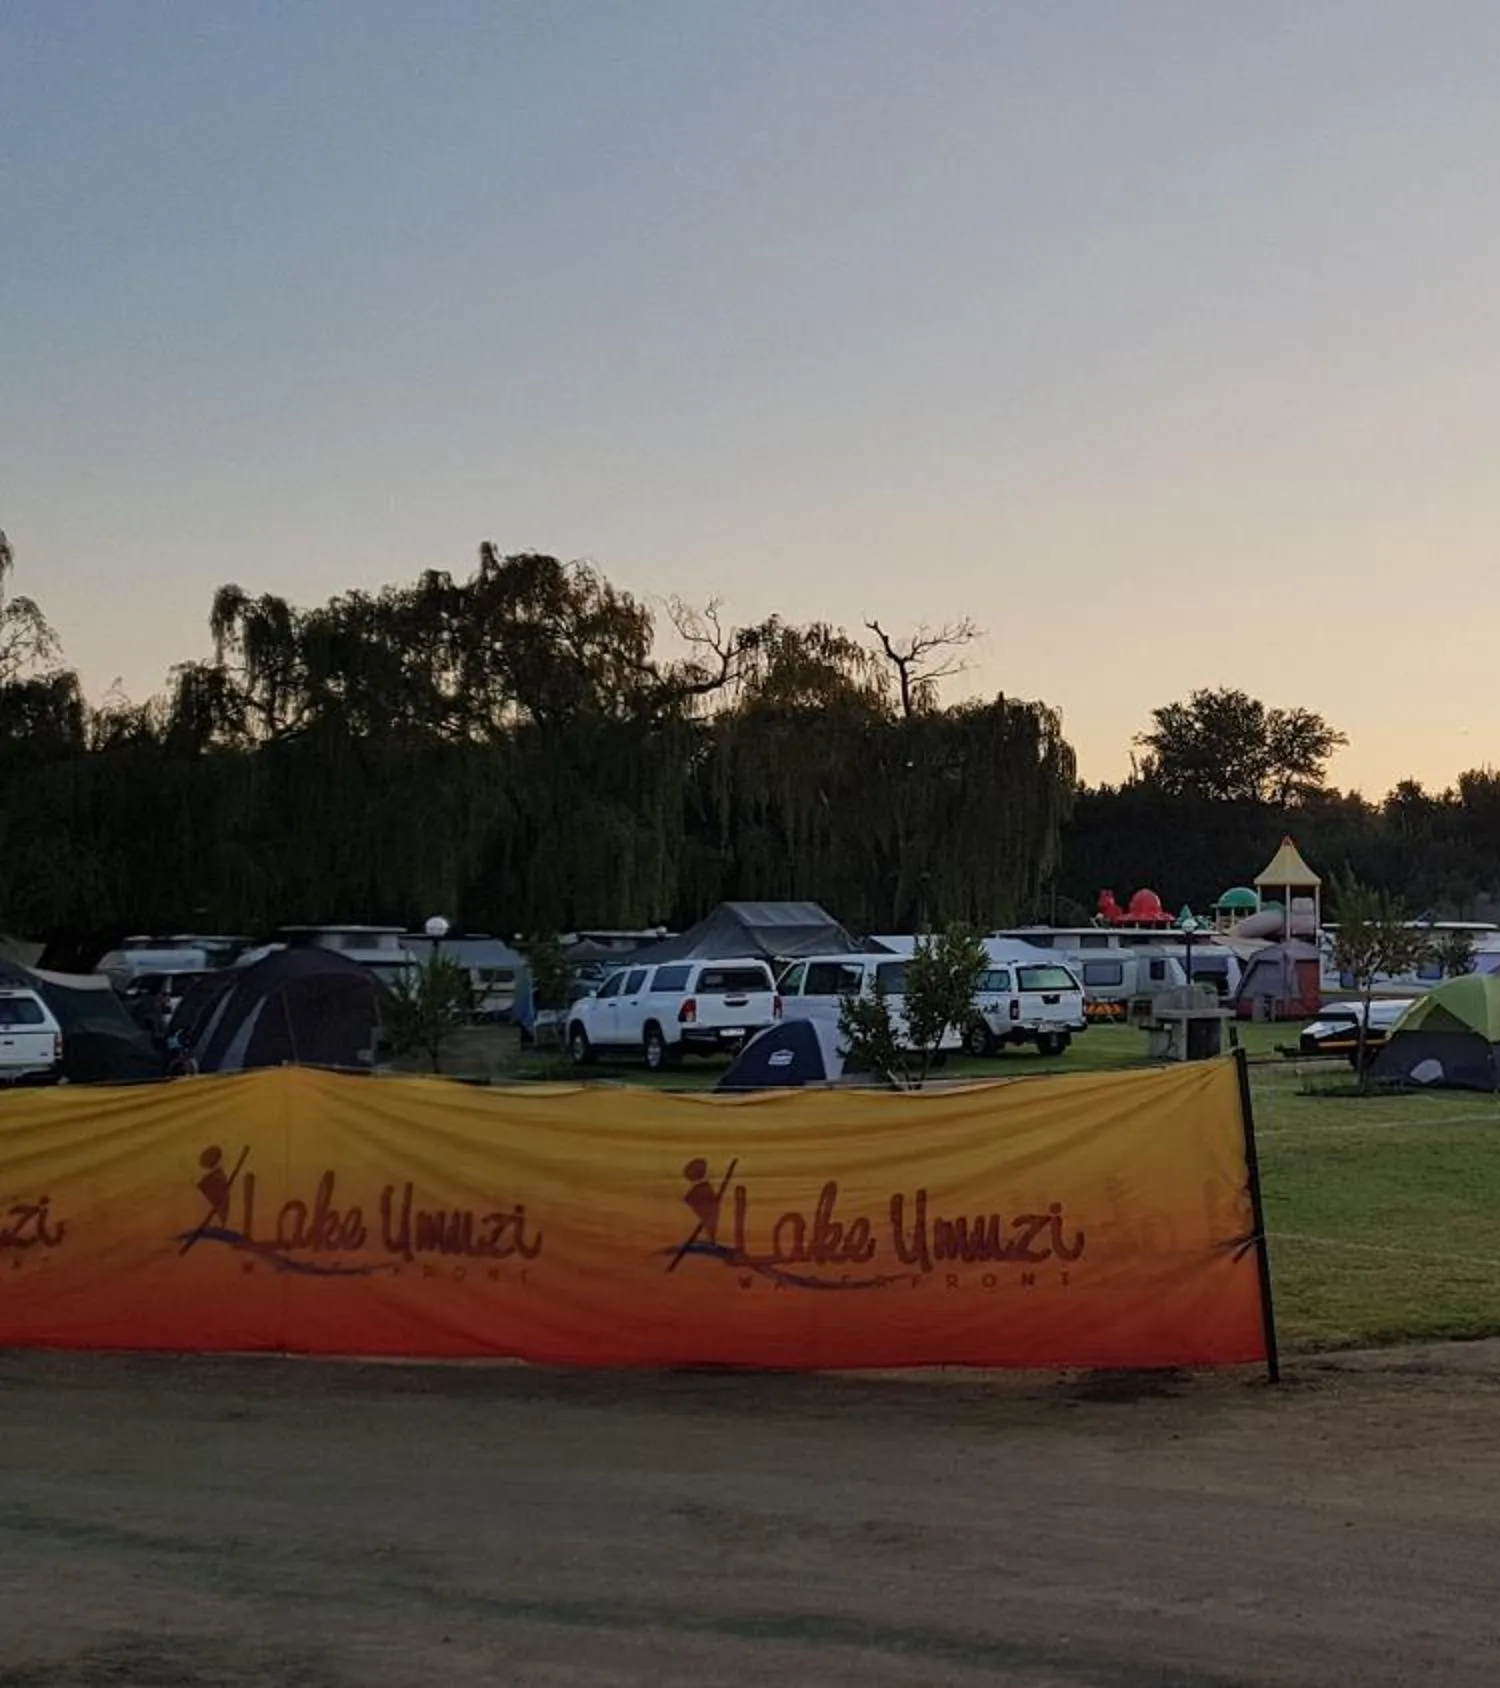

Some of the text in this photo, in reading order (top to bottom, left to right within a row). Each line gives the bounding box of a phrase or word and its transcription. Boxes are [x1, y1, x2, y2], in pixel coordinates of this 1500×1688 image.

[0, 1195, 65, 1249] zi
[232, 1170, 542, 1263] Lake Umuzi
[727, 1180, 1085, 1273] Lake Umuzi
